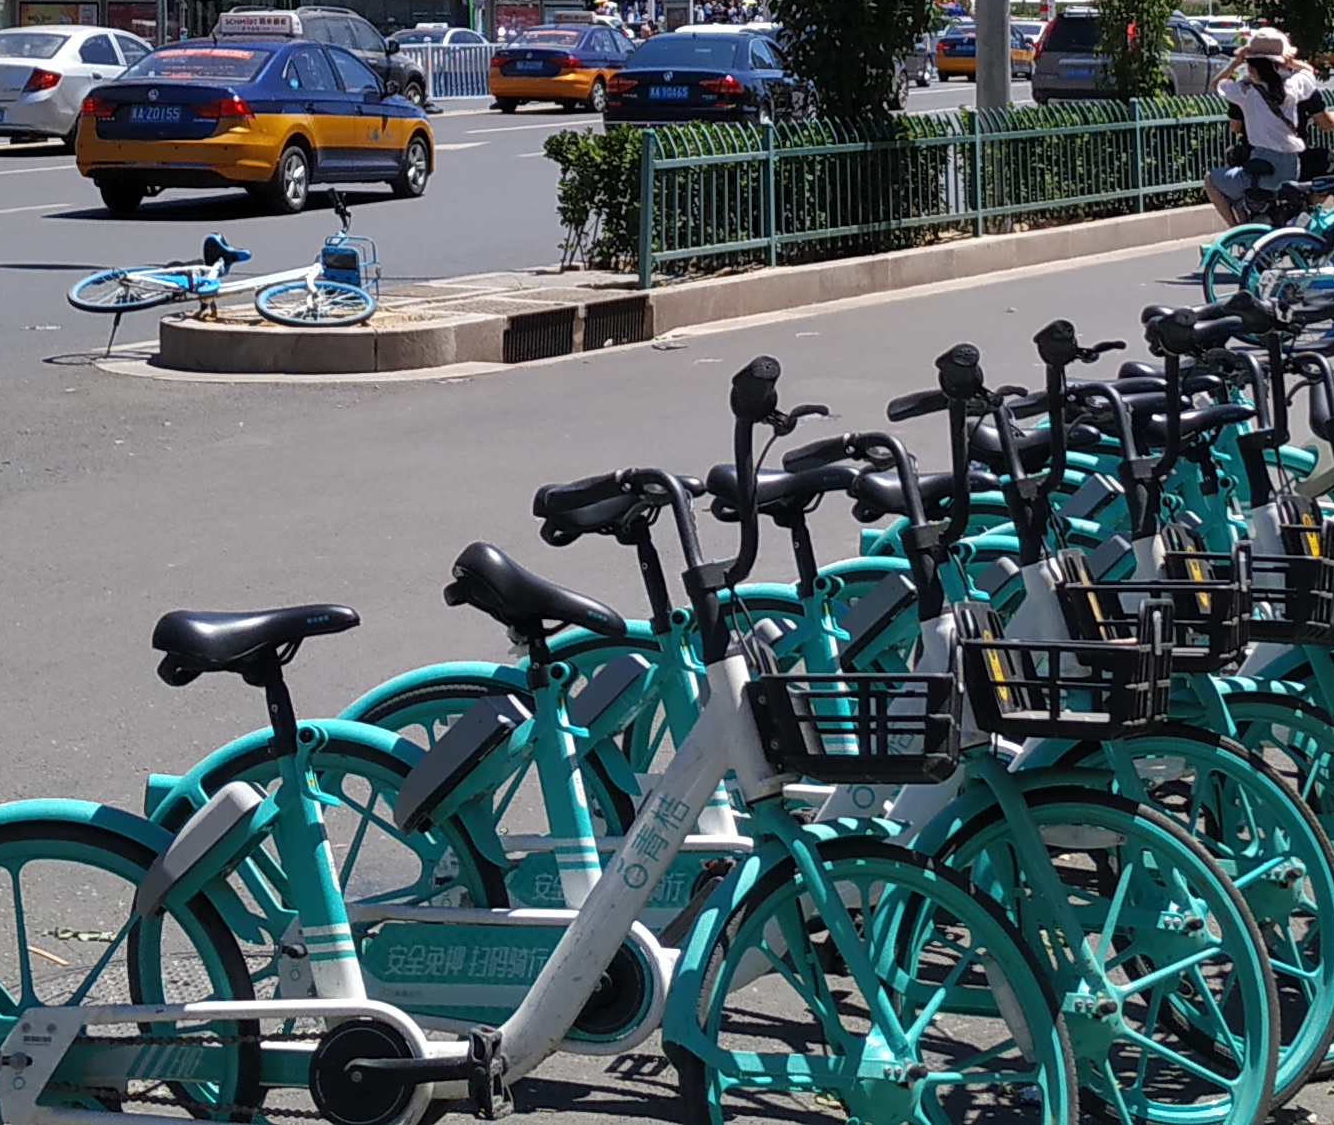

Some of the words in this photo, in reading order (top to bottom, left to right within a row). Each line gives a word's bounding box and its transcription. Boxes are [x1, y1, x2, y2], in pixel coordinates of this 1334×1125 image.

[630, 792, 690, 863] 青桔
[385, 944, 467, 976] 安全免押
[470, 945, 551, 979] 扫码骑行
